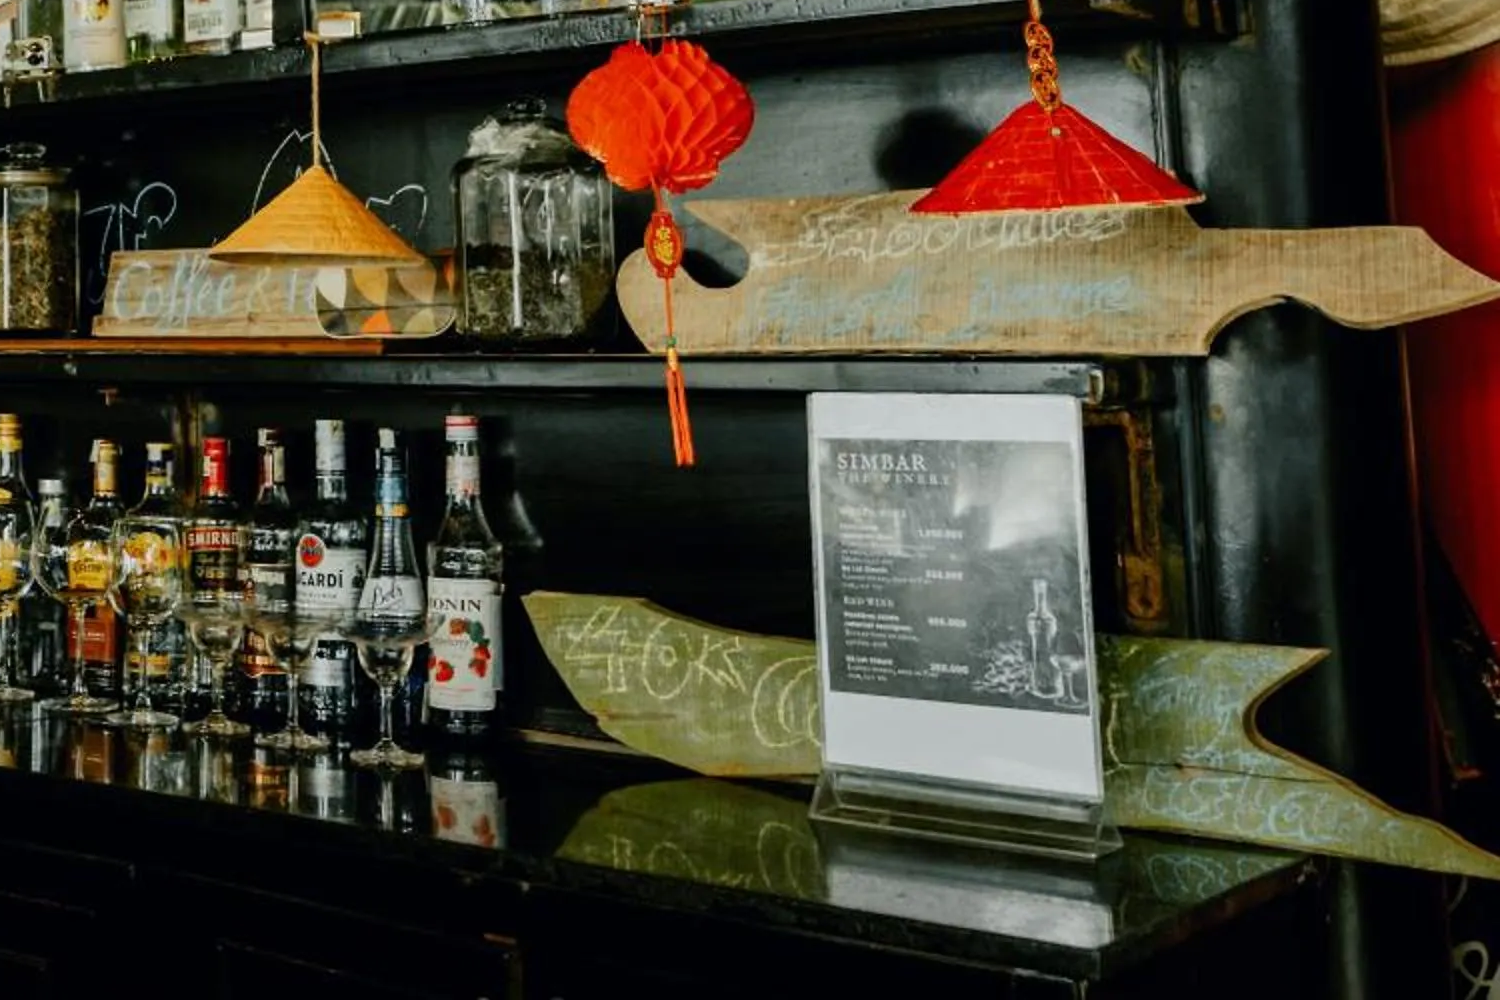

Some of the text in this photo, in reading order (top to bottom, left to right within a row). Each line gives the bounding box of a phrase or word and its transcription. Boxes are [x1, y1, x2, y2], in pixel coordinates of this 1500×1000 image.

[113, 252, 235, 334] Coffee
[837, 452, 927, 471] SIMBAR
[300, 570, 343, 588] CARDÍ
[433, 599, 481, 612] ONIN
